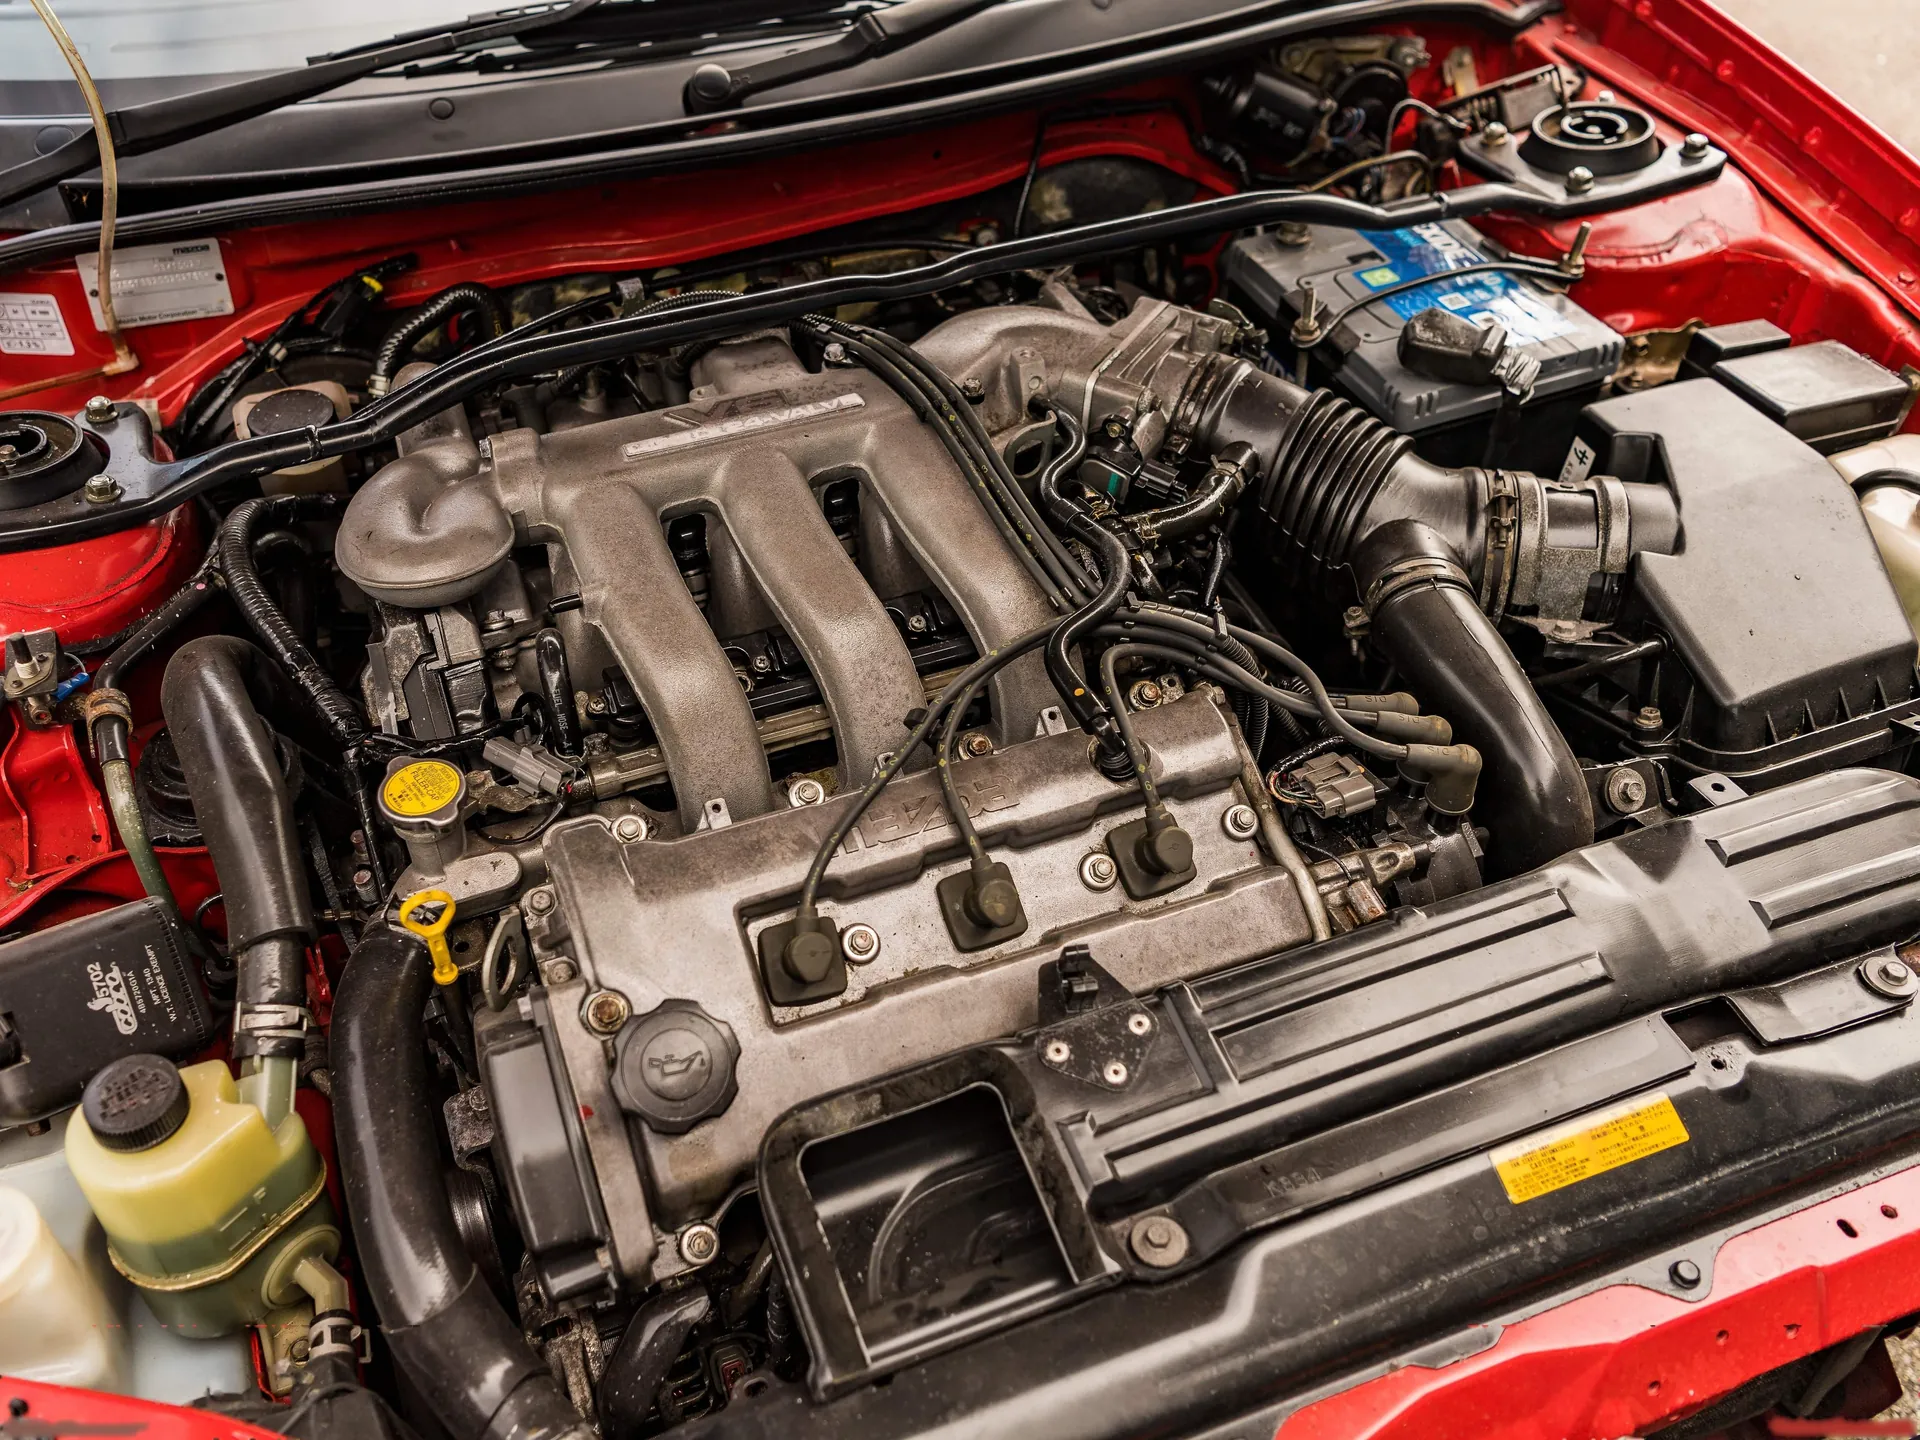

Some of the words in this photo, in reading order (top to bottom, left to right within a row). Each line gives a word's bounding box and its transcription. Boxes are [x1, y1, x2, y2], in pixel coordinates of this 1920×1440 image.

[172, 243, 210, 256] mazda
[556, 713, 569, 731] HOSE
[144, 944, 161, 980] EXEMPT
[87, 961, 110, 999] 5702
[143, 968, 156, 985] 1340
[156, 972, 172, 1006] LICENCE
[1529, 1156, 1557, 1170] CAUTION
